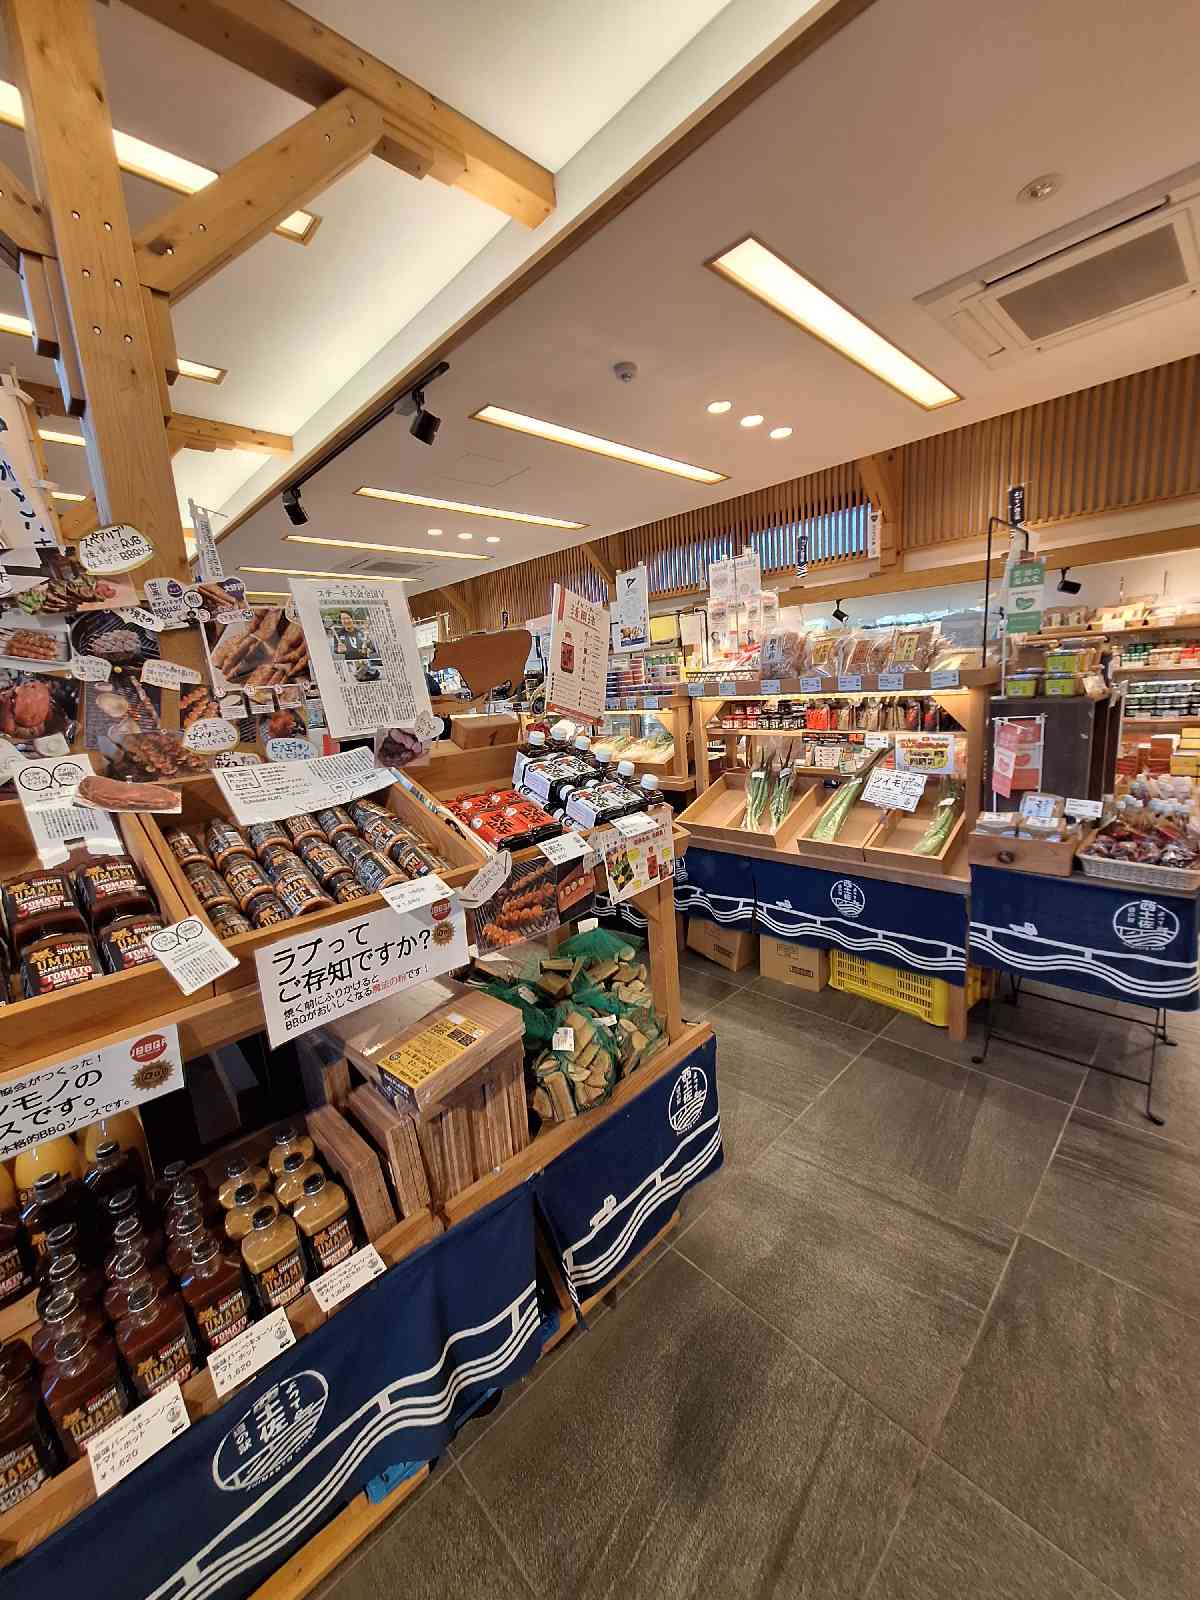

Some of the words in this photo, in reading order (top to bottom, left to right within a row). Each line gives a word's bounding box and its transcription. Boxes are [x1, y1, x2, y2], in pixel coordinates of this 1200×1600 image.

[37, 952, 90, 971] UMAMI
[46, 965, 92, 983] TOMATO
[279, 929, 431, 1003] ご存知ですか？
[284, 974, 380, 1019] 焼く前にふりかけると
